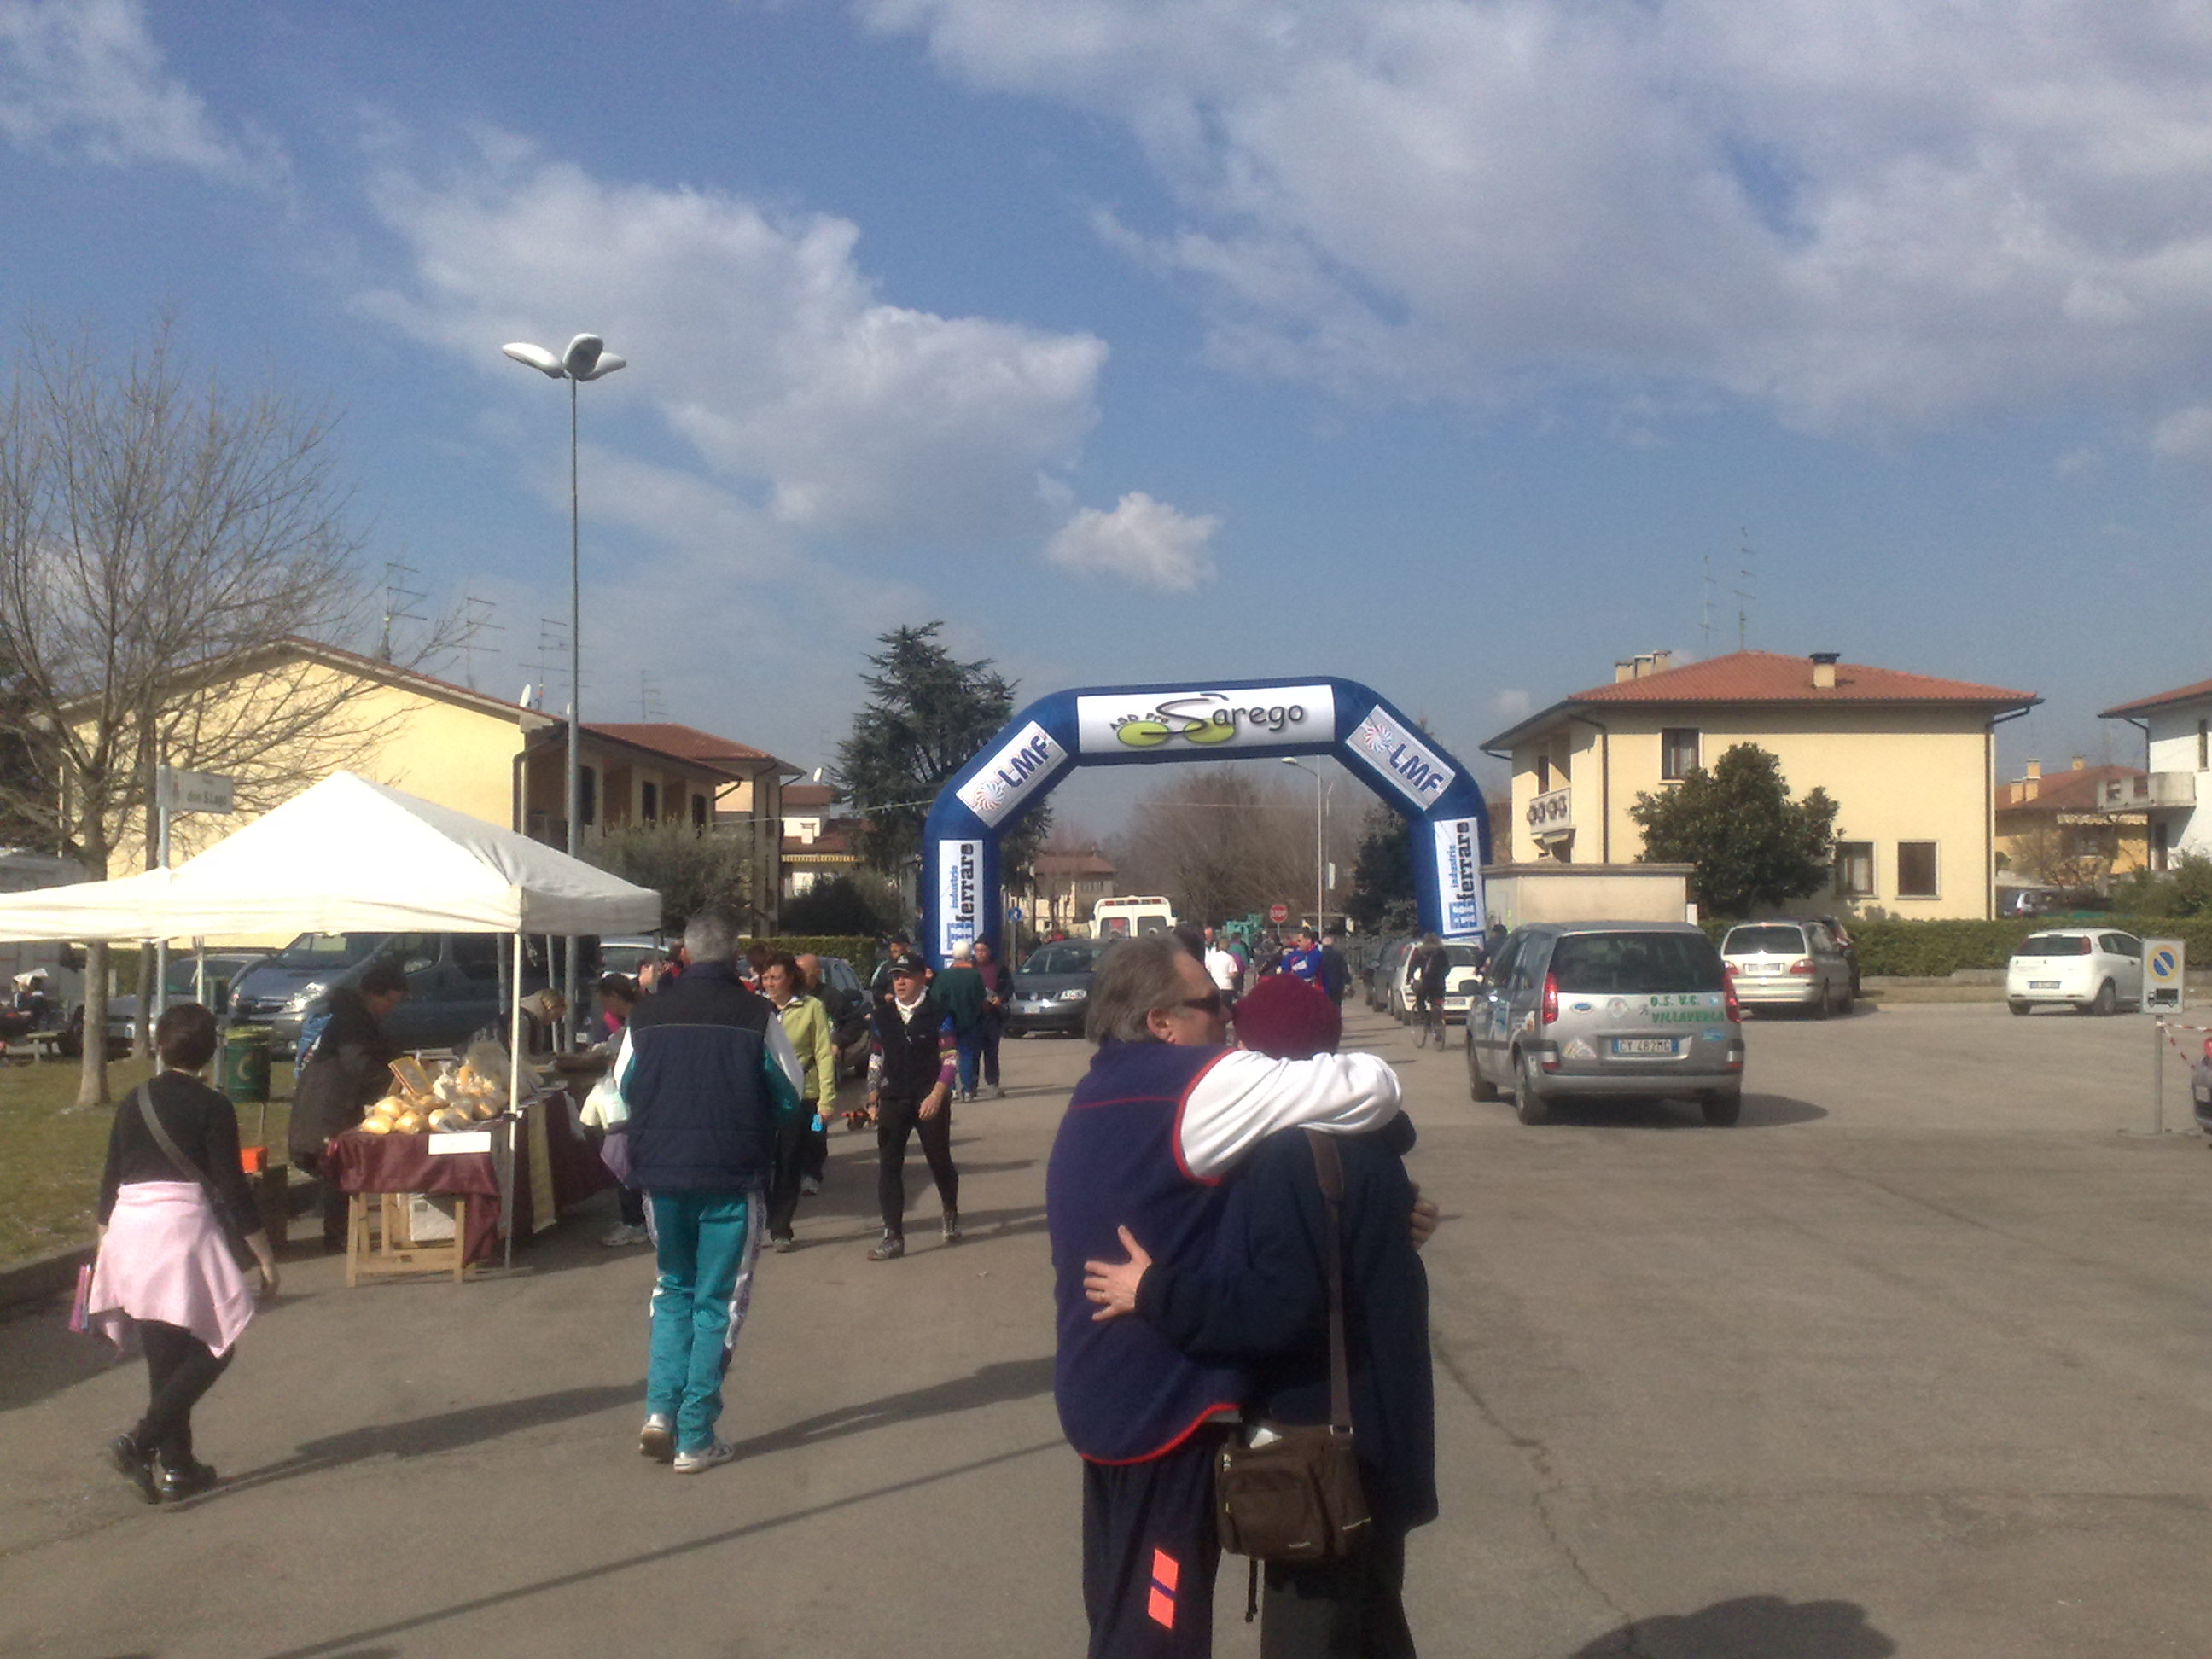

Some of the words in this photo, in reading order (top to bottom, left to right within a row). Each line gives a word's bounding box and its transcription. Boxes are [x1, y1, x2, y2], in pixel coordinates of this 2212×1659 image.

[1109, 713, 1138, 731] ASD
[1145, 713, 1169, 724] Pro
[1141, 693, 1305, 736] Sarego
[998, 736, 1051, 789] LMF
[1389, 744, 1444, 793] LMF
